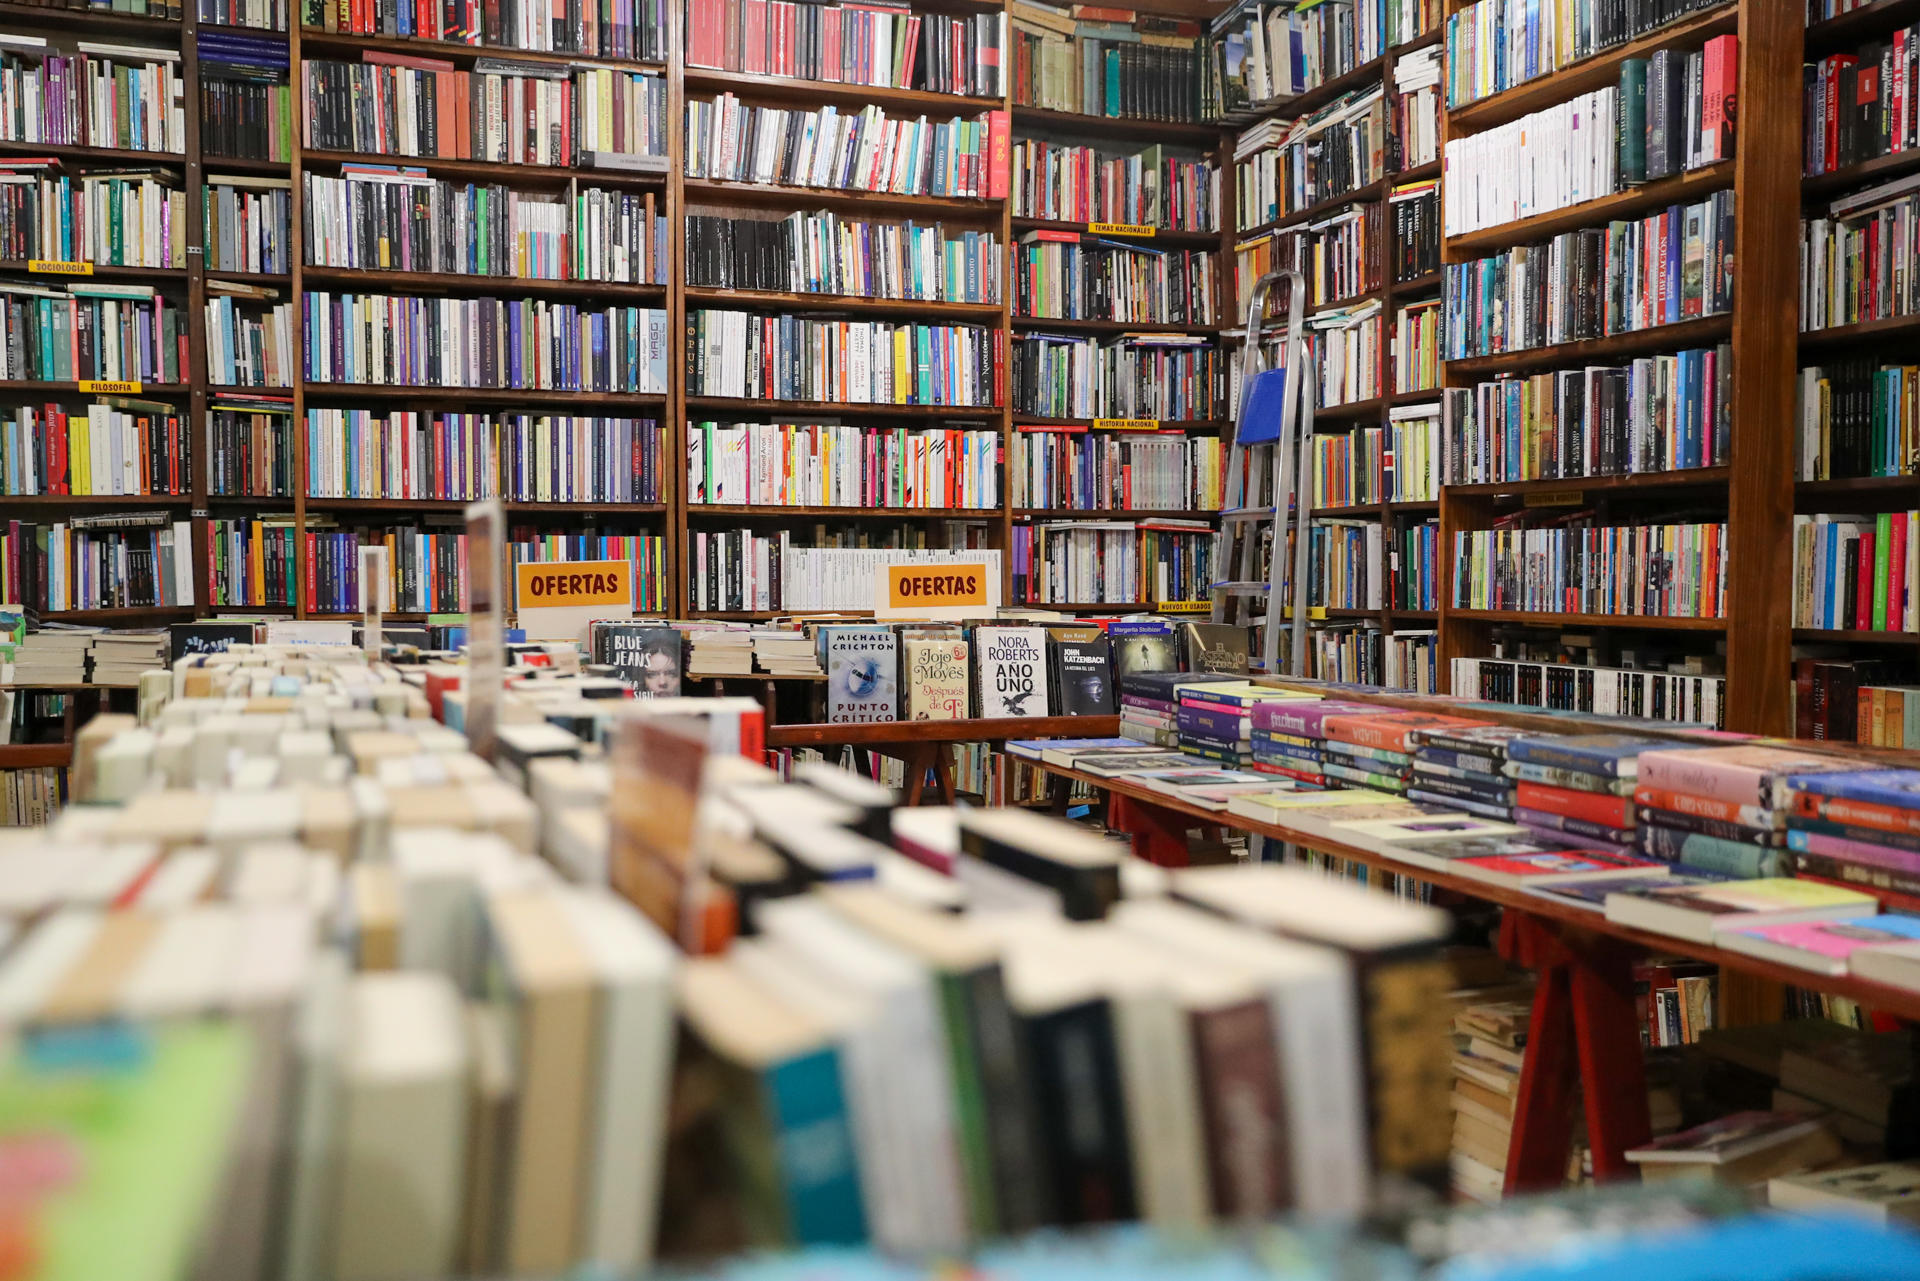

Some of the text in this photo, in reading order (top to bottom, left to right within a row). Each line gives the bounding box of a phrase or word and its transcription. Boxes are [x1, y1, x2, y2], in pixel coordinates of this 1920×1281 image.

[530, 573, 618, 596] OFERTAS
[900, 576, 976, 596] OFERTAS
[1162, 602, 1183, 610] NUEVOS
[614, 635, 642, 650] BLUE
[998, 636, 1030, 648] NORA
[613, 652, 652, 668] JEANS
[918, 648, 952, 669] Jojo
[988, 647, 1039, 661] ROBERTS
[1064, 656, 1105, 664] KATZENBACH
[914, 664, 964, 684] Moyes
[996, 662, 1033, 678] AÑO
[922, 684, 964, 698] Después
[996, 678, 1034, 692] UNO
[838, 703, 890, 712] PUNTO
[928, 697, 964, 720] de Ti
[832, 712, 894, 722] CRÍTICO
